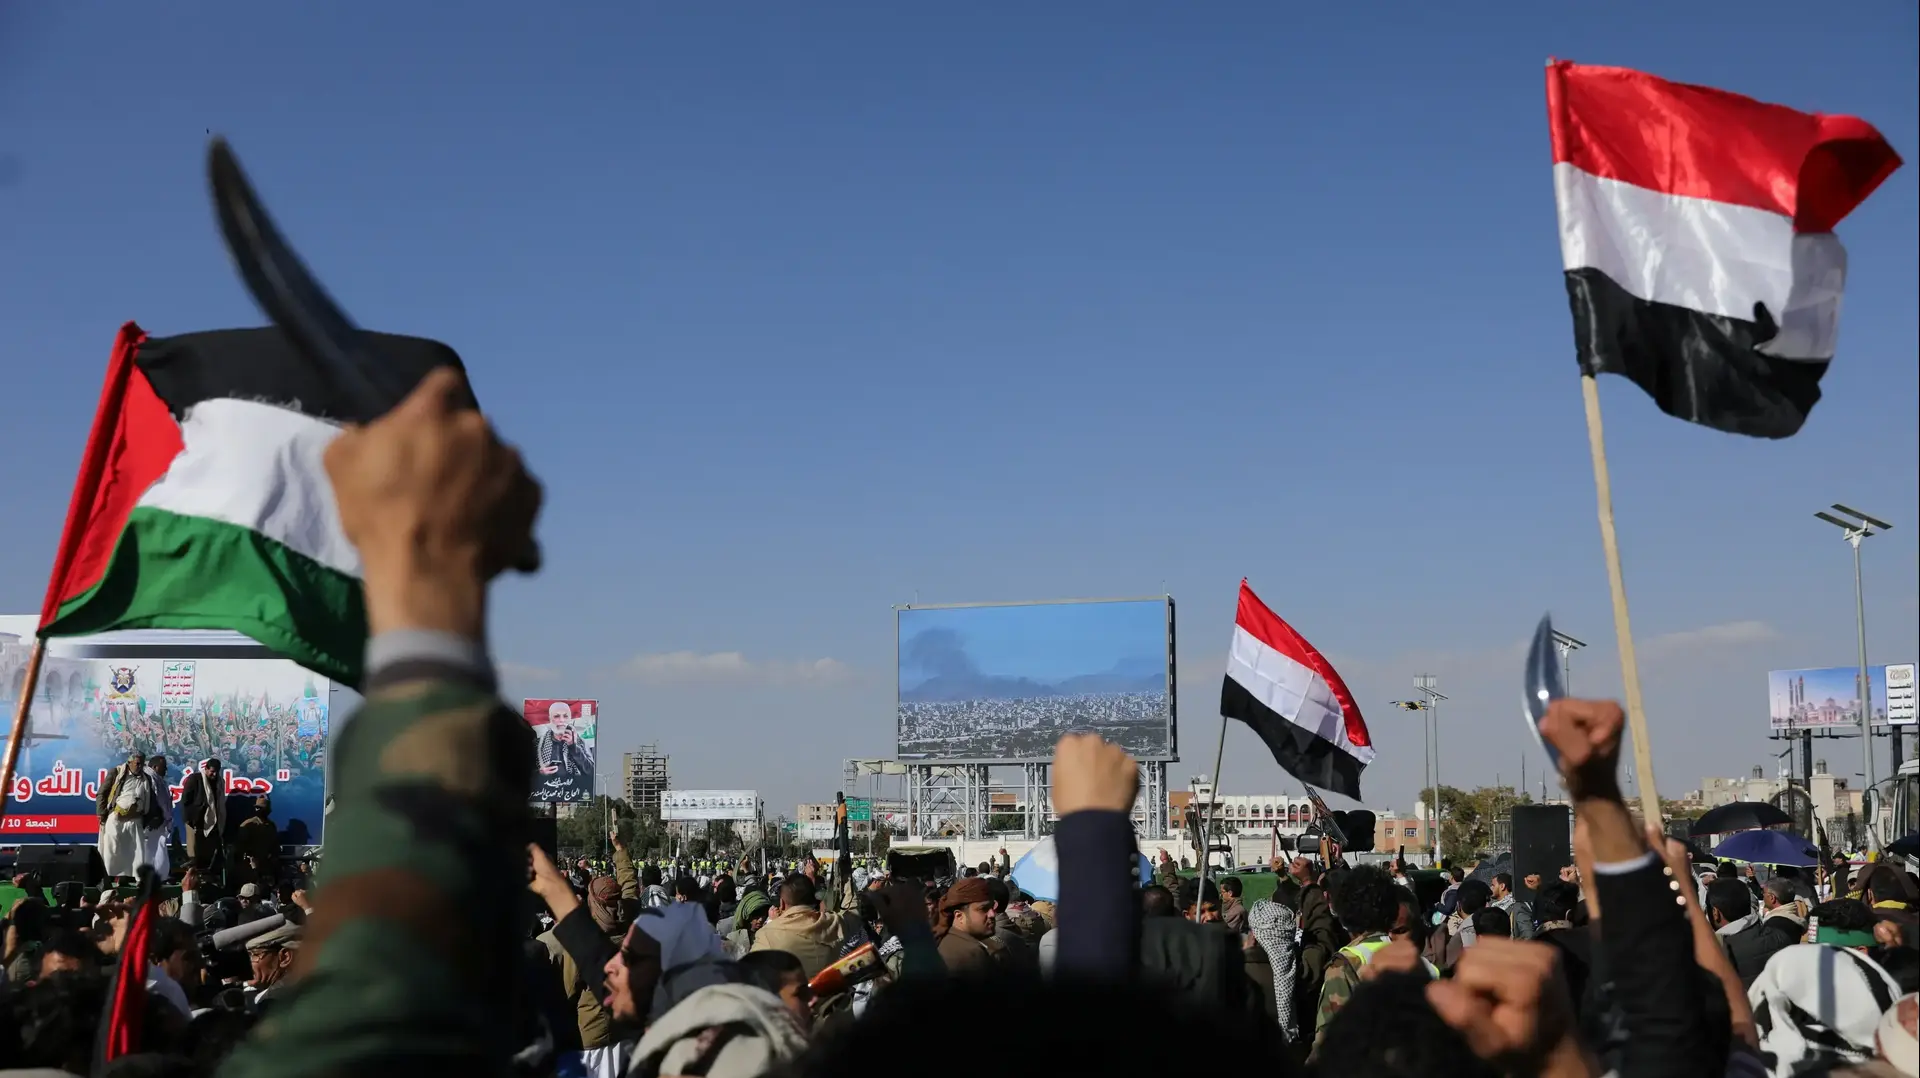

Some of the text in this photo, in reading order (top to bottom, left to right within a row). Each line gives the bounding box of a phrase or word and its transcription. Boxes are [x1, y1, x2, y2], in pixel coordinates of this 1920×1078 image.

[37, 762, 81, 795] الله
[8, 818, 21, 828] 10
[25, 818, 57, 829] الجمعة
